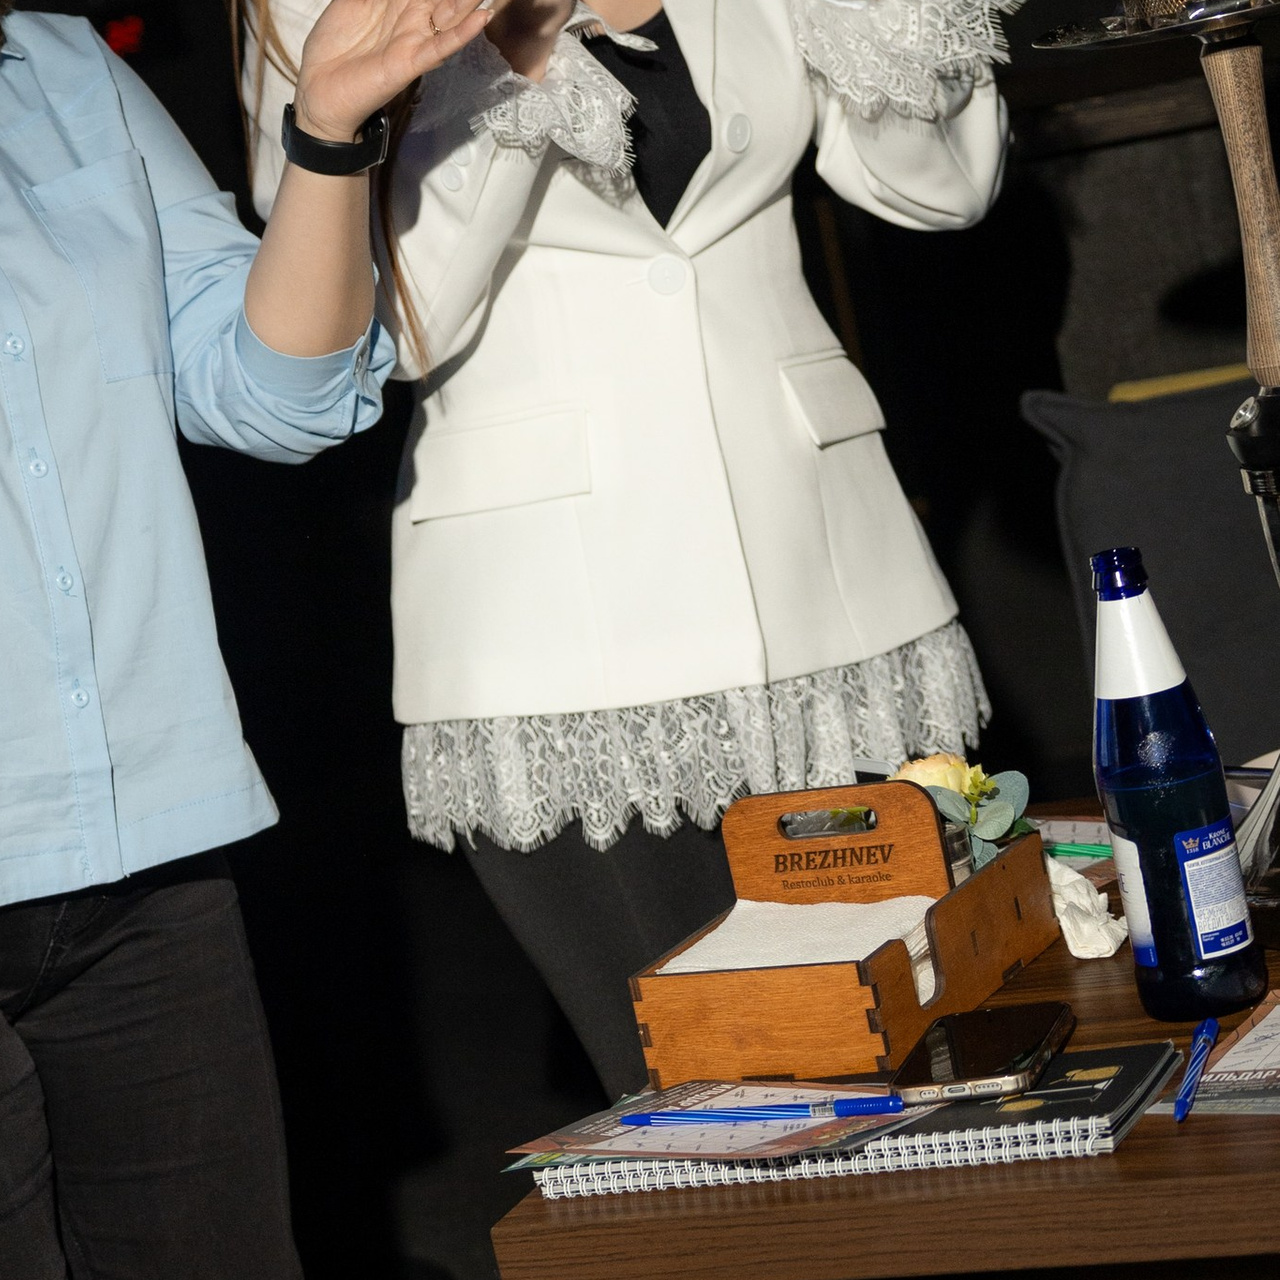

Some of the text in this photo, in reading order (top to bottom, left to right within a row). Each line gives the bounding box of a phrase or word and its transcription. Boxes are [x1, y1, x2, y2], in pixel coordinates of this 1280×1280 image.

[773, 844, 894, 873] BREZHNEV
[781, 871, 893, 890] Restoclub & karaoke
[1200, 1070, 1277, 1082] ИЛЬДАР
